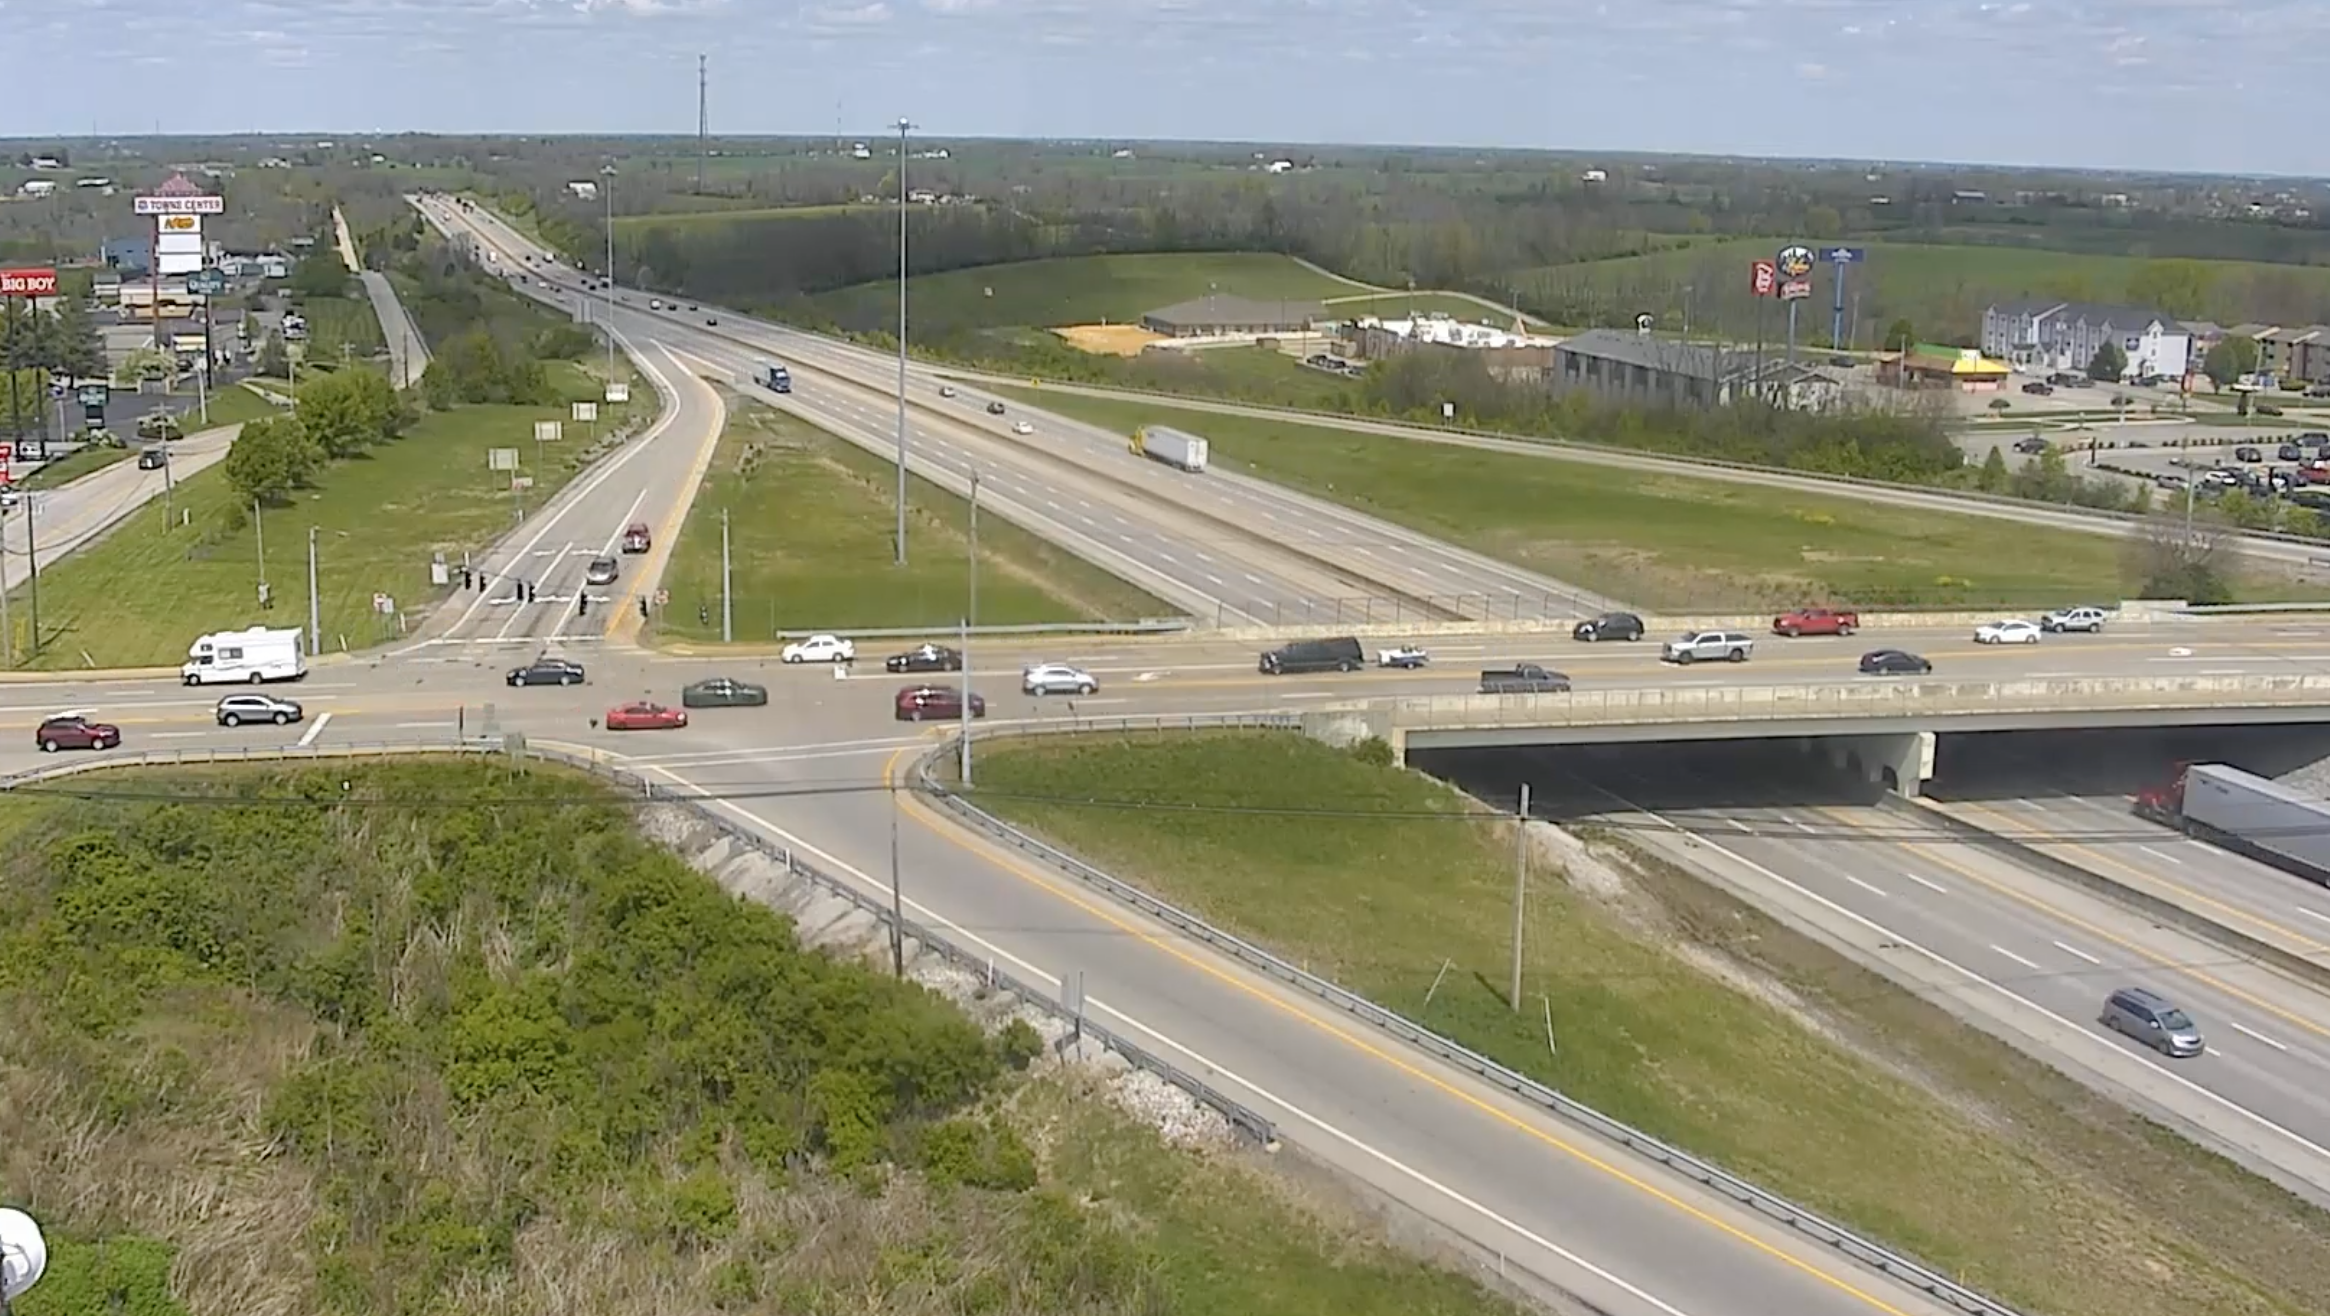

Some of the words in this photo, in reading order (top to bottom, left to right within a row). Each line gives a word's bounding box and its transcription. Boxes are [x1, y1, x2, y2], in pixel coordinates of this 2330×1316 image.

[184, 200, 220, 210] CENTER
[2, 277, 26, 291] BIG
[27, 277, 55, 291] BOY
